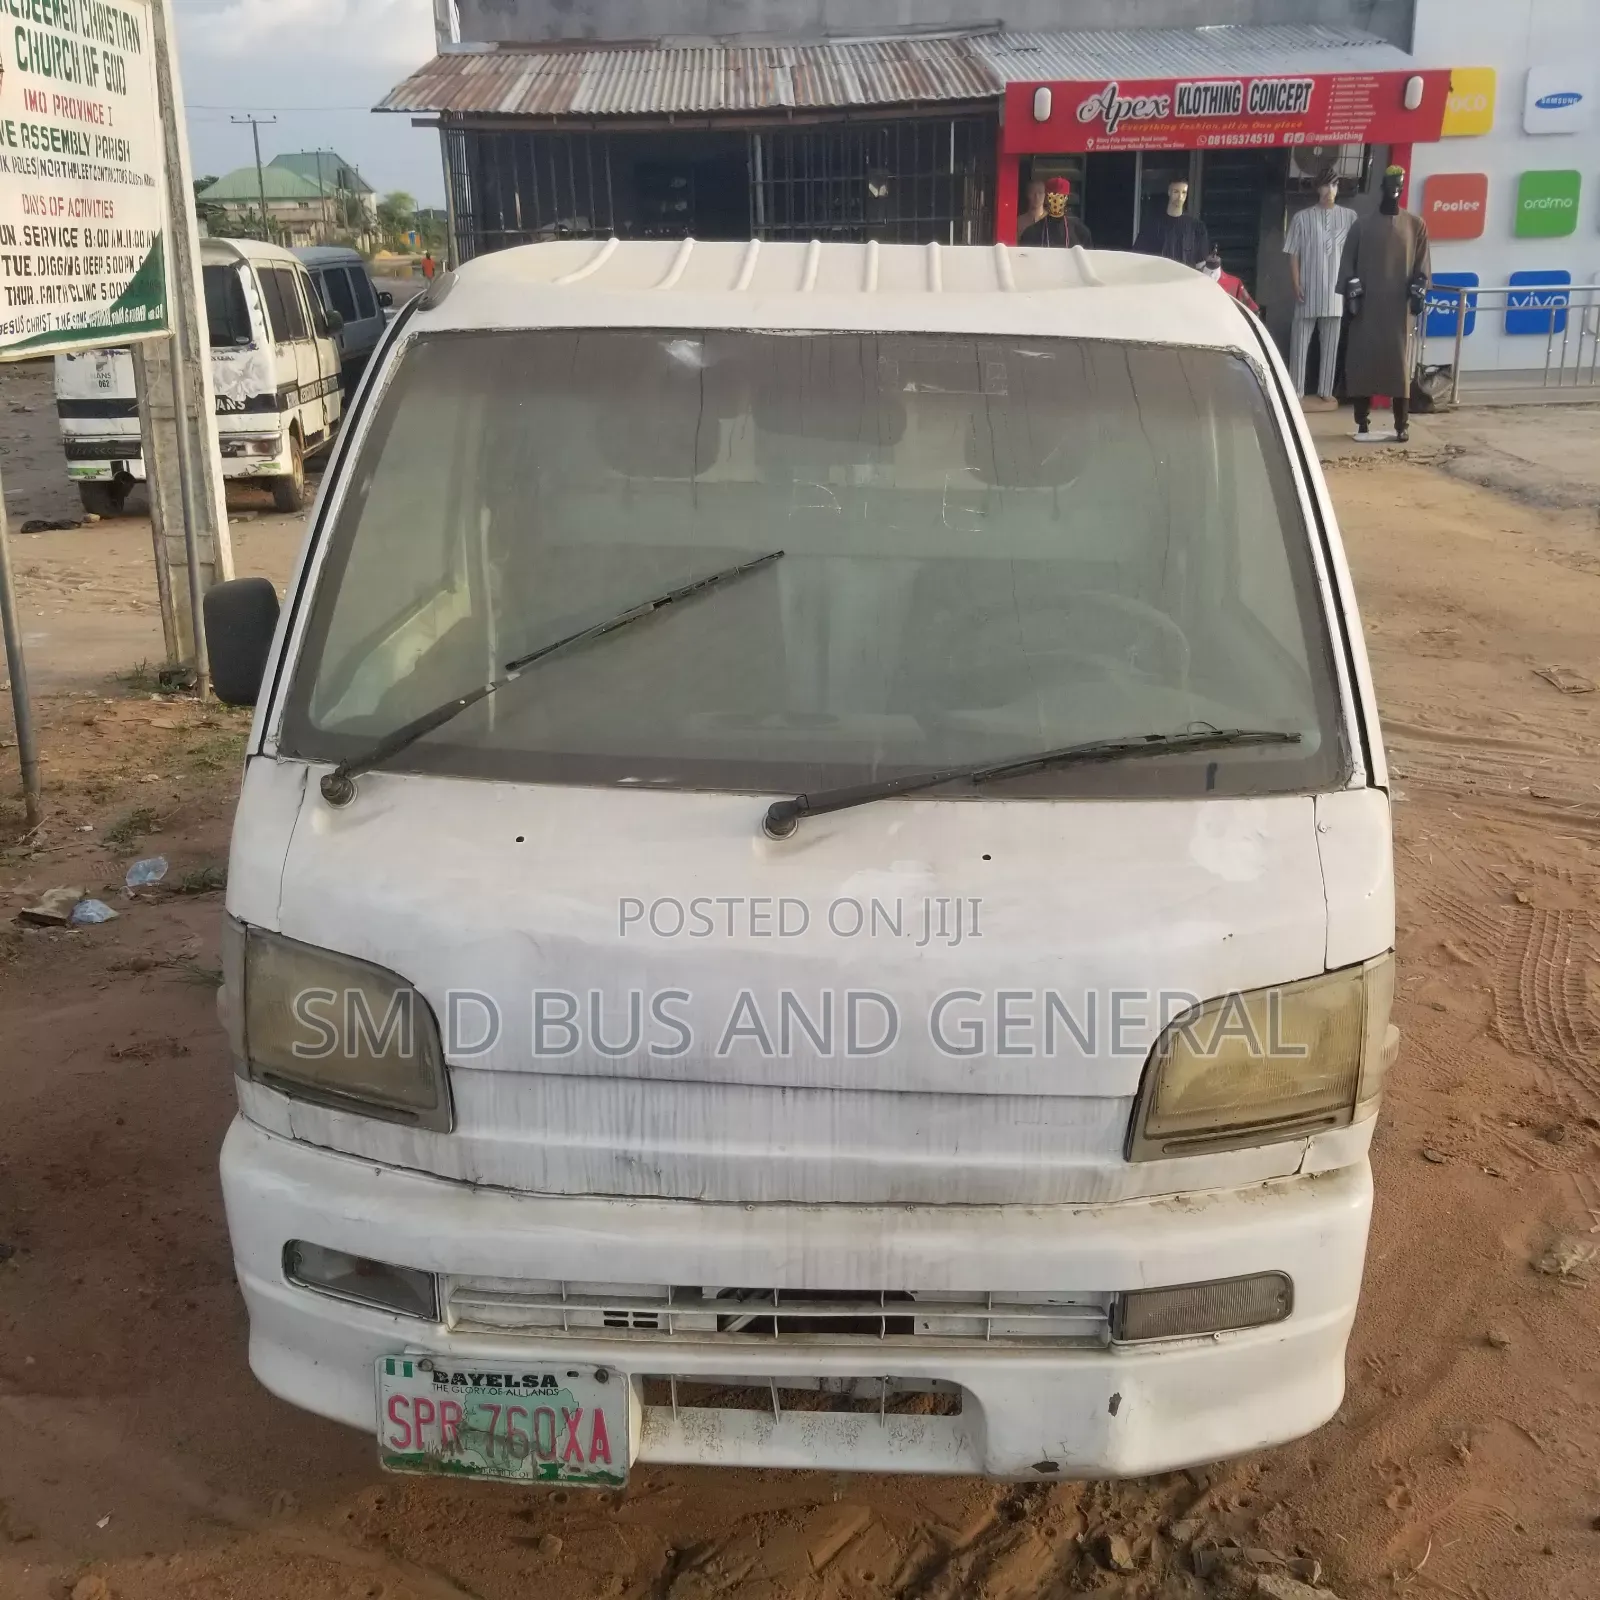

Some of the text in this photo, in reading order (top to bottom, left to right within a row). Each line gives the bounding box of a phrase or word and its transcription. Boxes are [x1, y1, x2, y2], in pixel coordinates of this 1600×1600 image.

[15, 26, 127, 96] CHURCH OF GOD
[24, 88, 113, 127] IMO PROVINCE I
[1077, 78, 1315, 135] Apex KLOTHING CONCEPT
[1448, 93, 1487, 113] OCO
[1541, 96, 1579, 105] SAMSUNG
[1120, 123, 1177, 132] Everything
[20, 122, 91, 157] ASSEMBLY
[95, 134, 131, 163] PARISH
[1207, 133, 1275, 145] 08165374510
[21, 193, 114, 219] DAYS OF ACTIVITIES
[1524, 197, 1573, 209] oraimo
[23, 225, 78, 248] SERVICE
[1511, 291, 1567, 309] vivo
[26, 312, 52, 334] CHRIST
[98, 379, 110, 388] 062
[432, 1370, 559, 1388] BAYELSA
[432, 1383, 449, 1393] THE
[451, 1385, 486, 1395] GLORY
[488, 1388, 503, 1396] OF
[525, 1388, 560, 1397] LANDS
[388, 1394, 612, 1464] SPR 760XA
